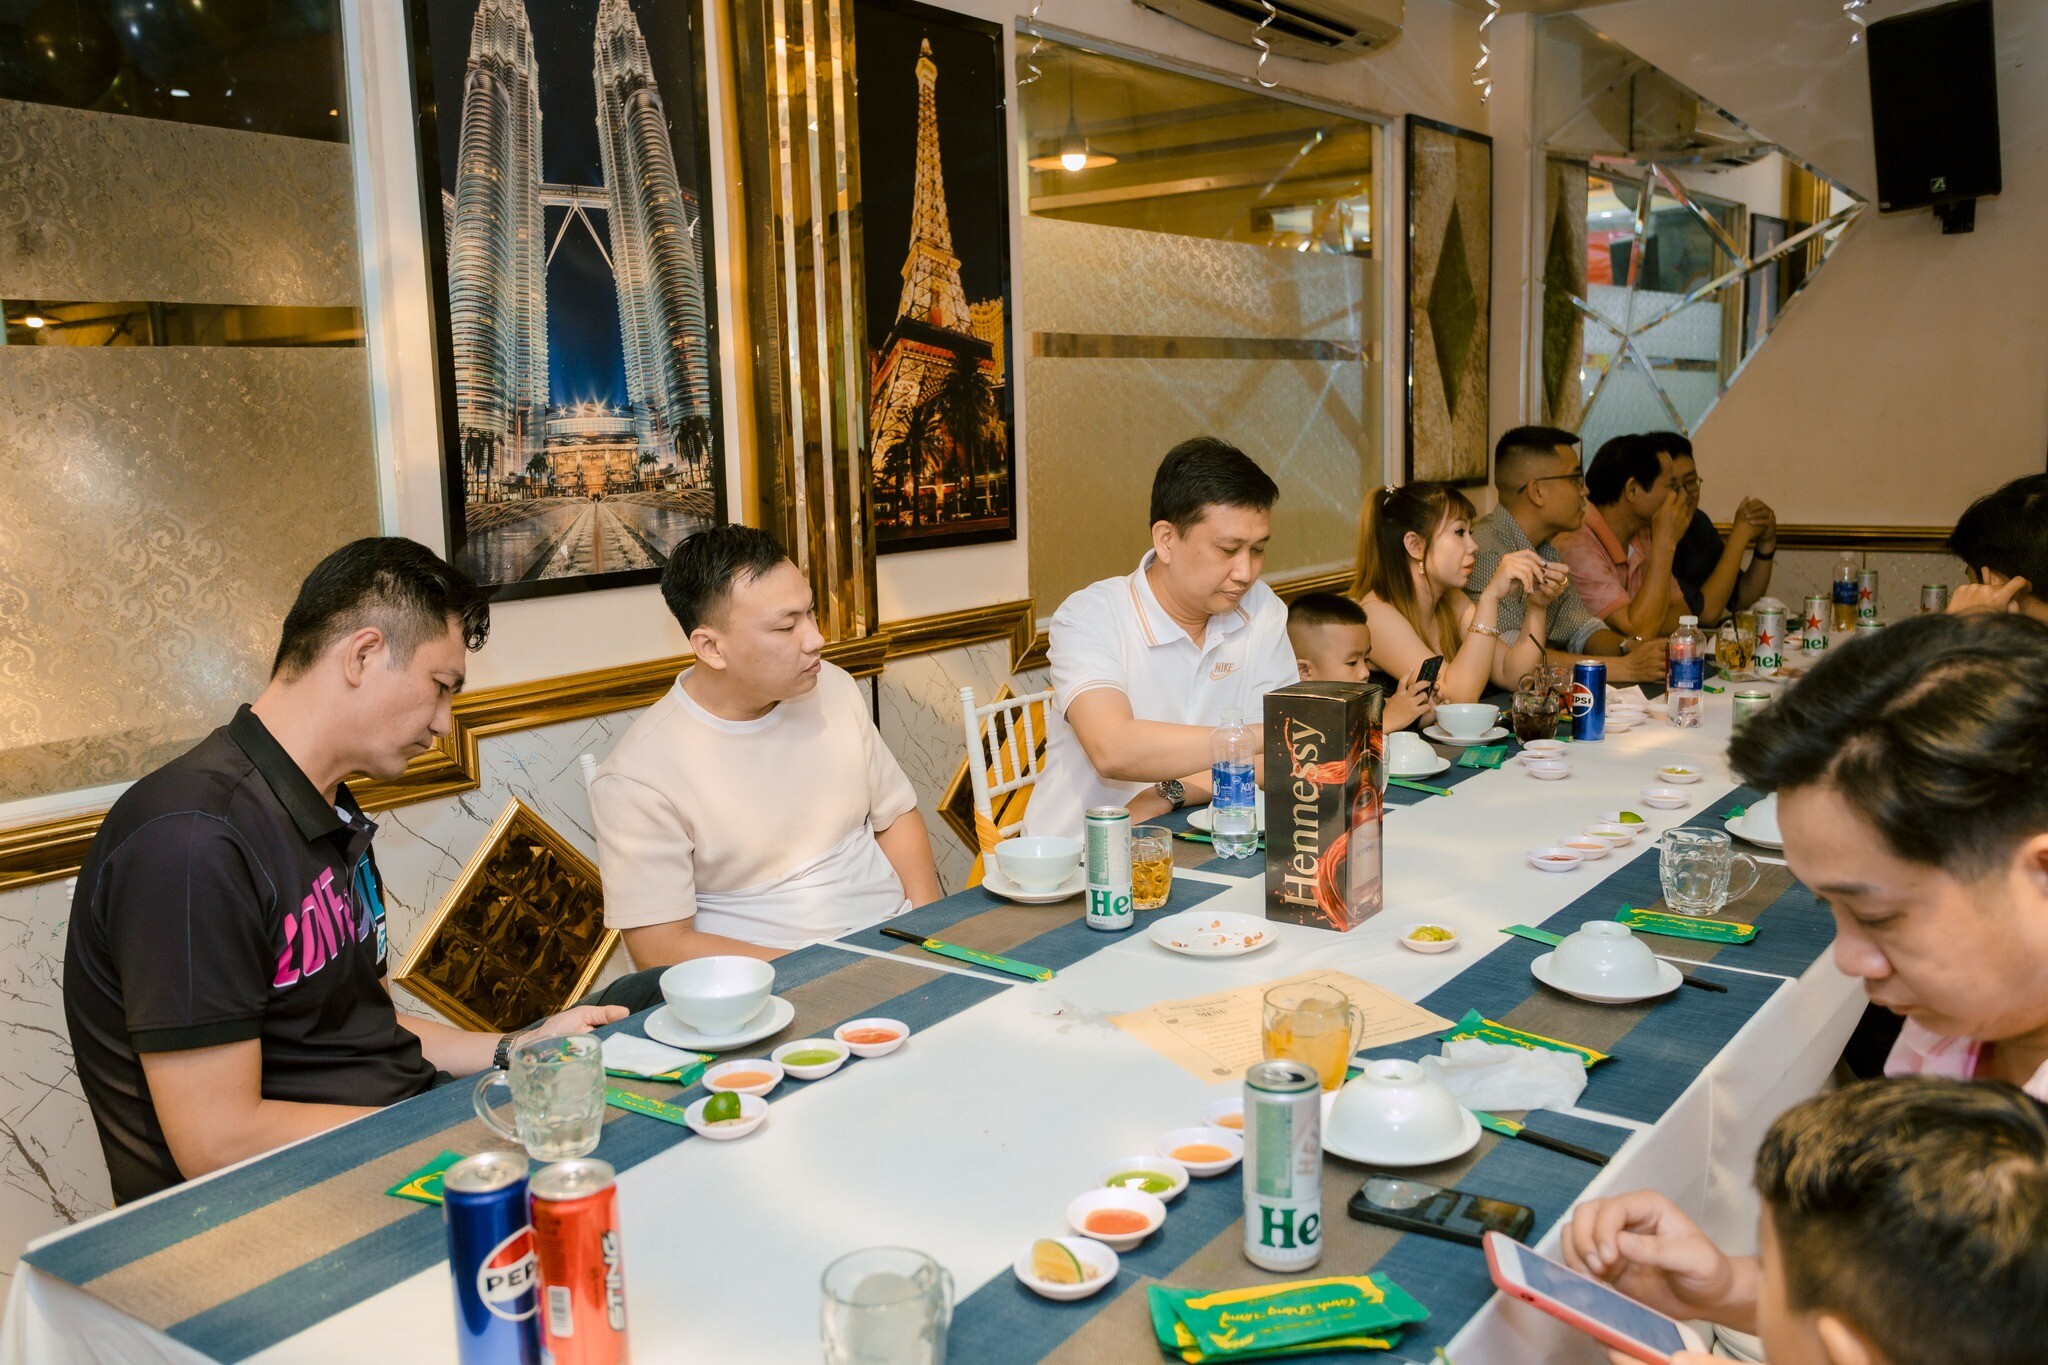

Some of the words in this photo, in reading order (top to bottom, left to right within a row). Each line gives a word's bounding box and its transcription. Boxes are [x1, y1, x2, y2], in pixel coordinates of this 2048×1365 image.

[1214, 662, 1235, 673] NIKE
[1283, 717, 1327, 908] Hennessy
[602, 1229, 626, 1332] STING
